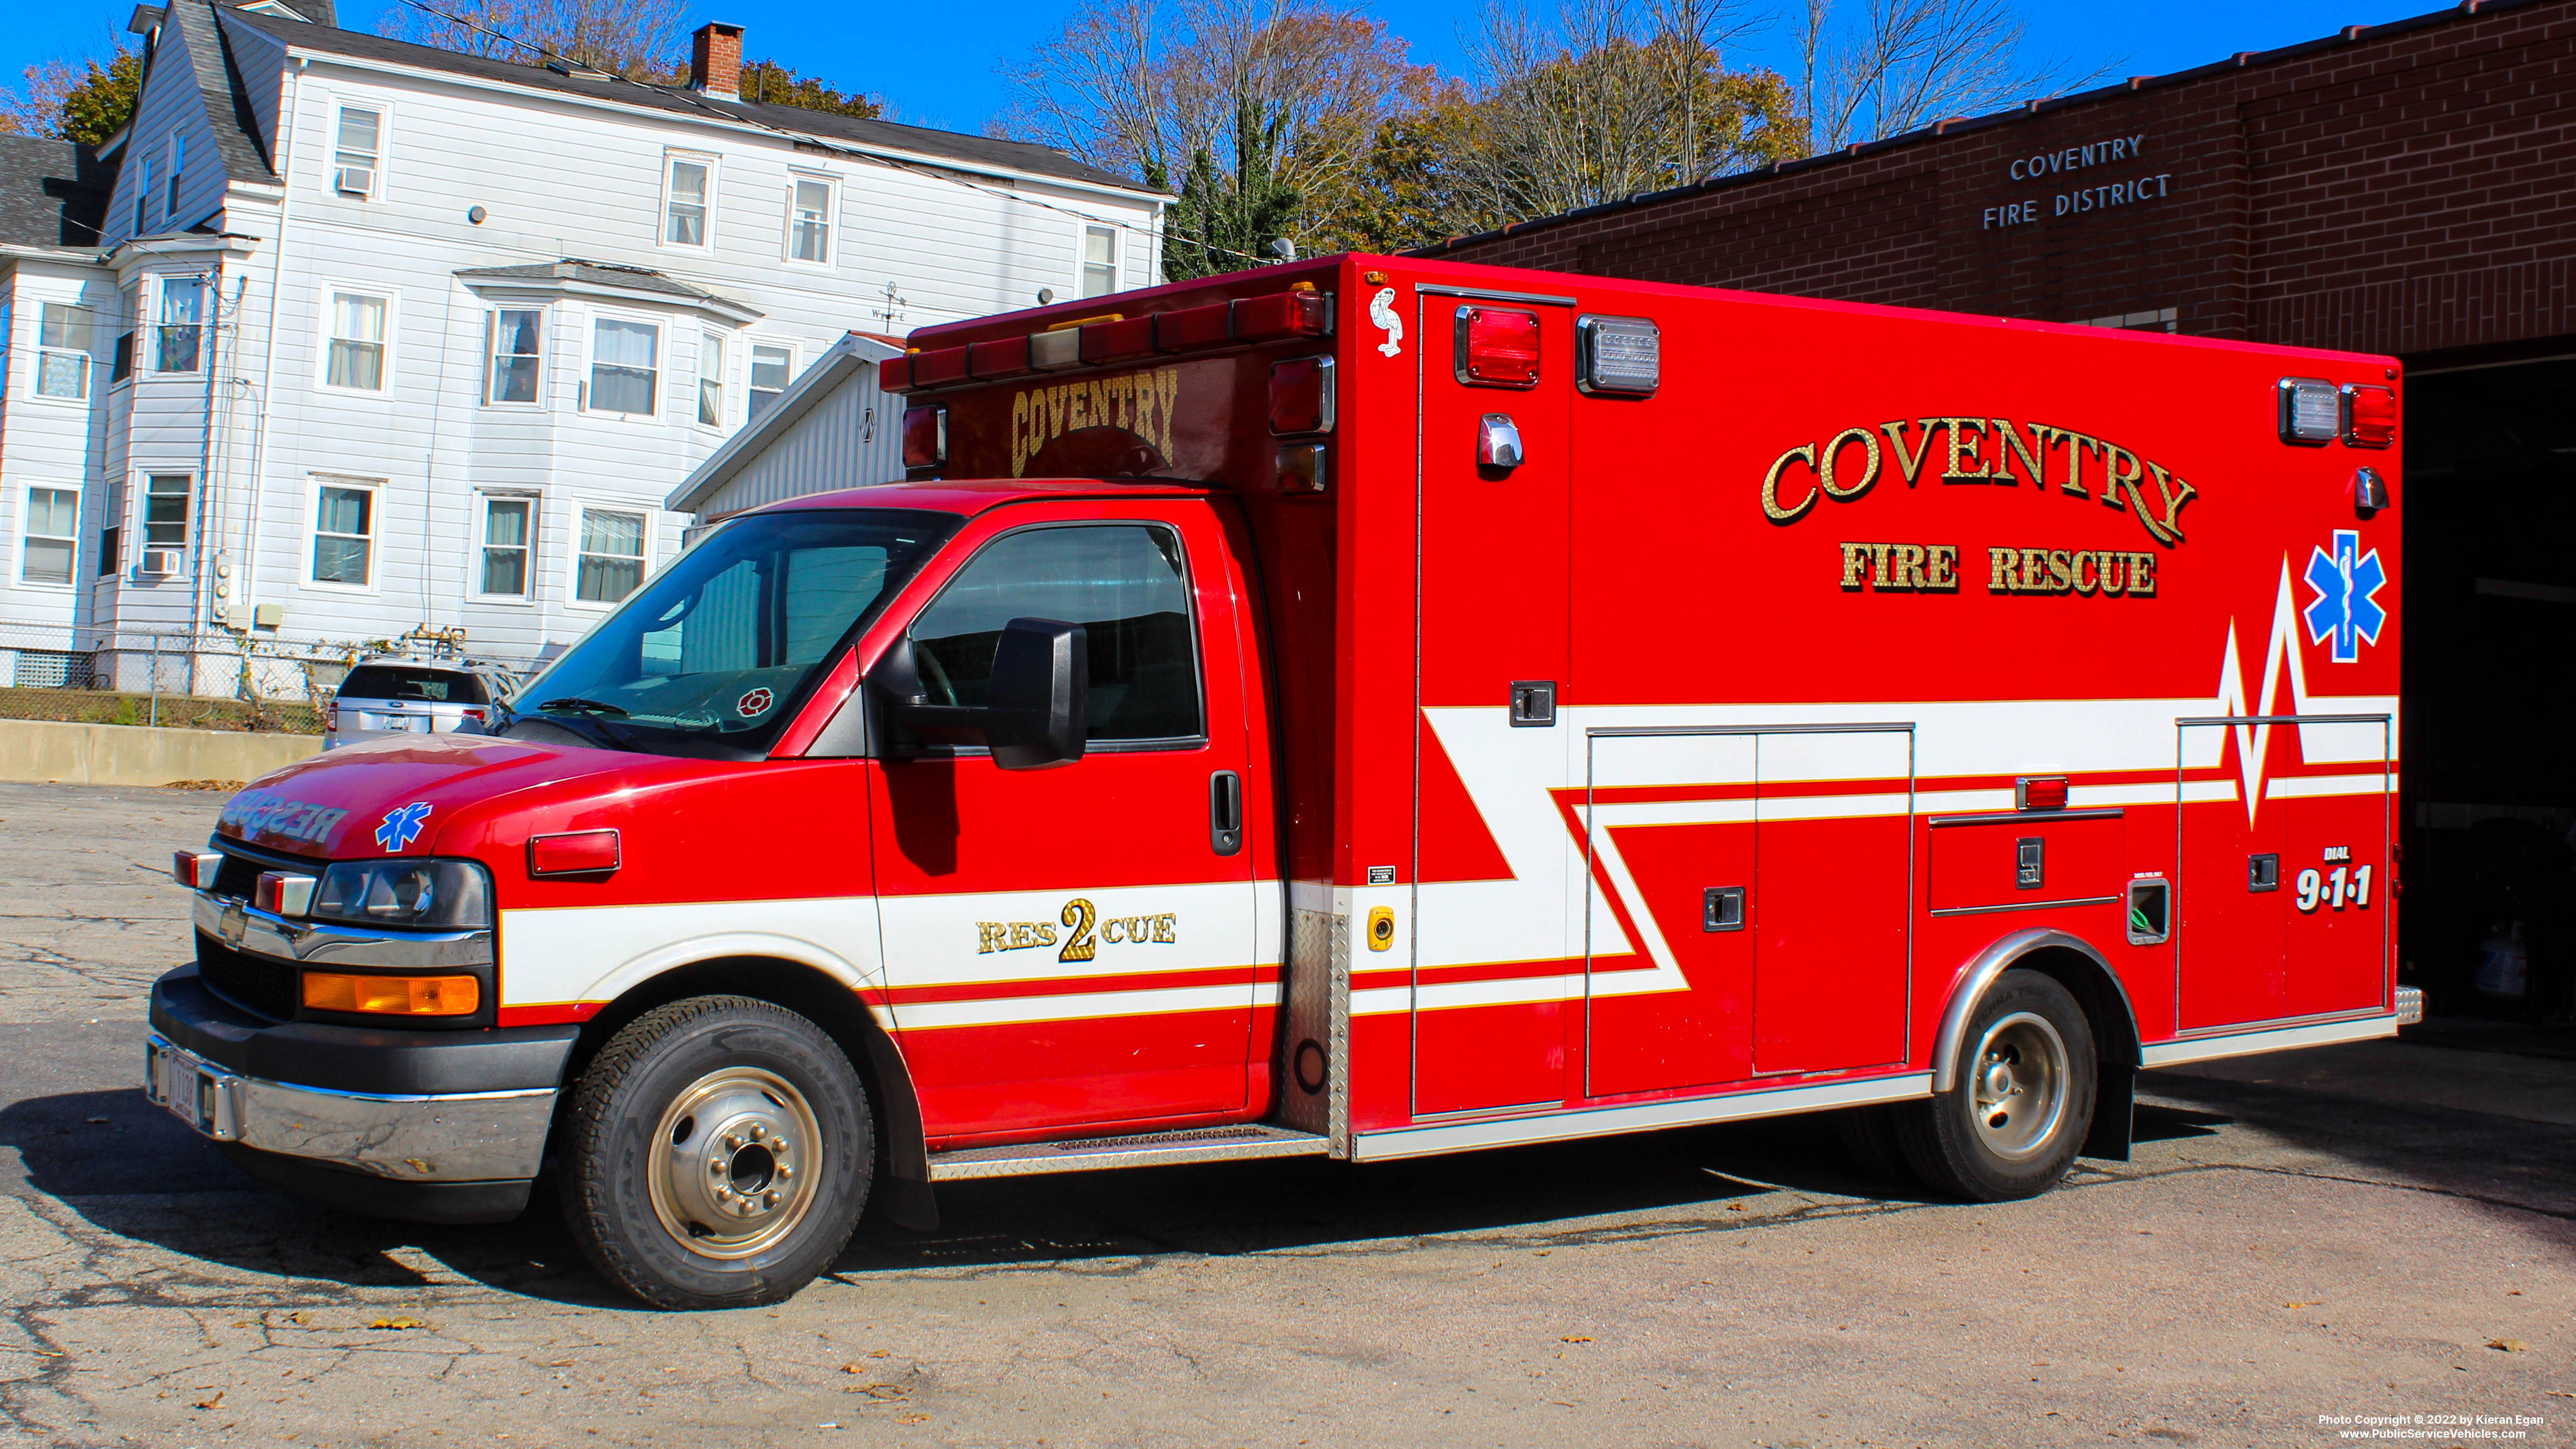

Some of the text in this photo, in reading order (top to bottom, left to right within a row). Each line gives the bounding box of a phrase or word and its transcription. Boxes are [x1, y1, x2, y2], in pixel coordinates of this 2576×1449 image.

[2010, 134, 2144, 181] COVENTRY
[1983, 173, 2172, 230] FIRE DISTRICT
[1012, 369, 1178, 479] COVENTRY
[1760, 417, 2199, 549] COVENTRY
[1840, 542, 2158, 598] FIRE RESCUE
[2323, 845, 2352, 864] DIAL
[975, 898, 1176, 963] RES 2 CUE
